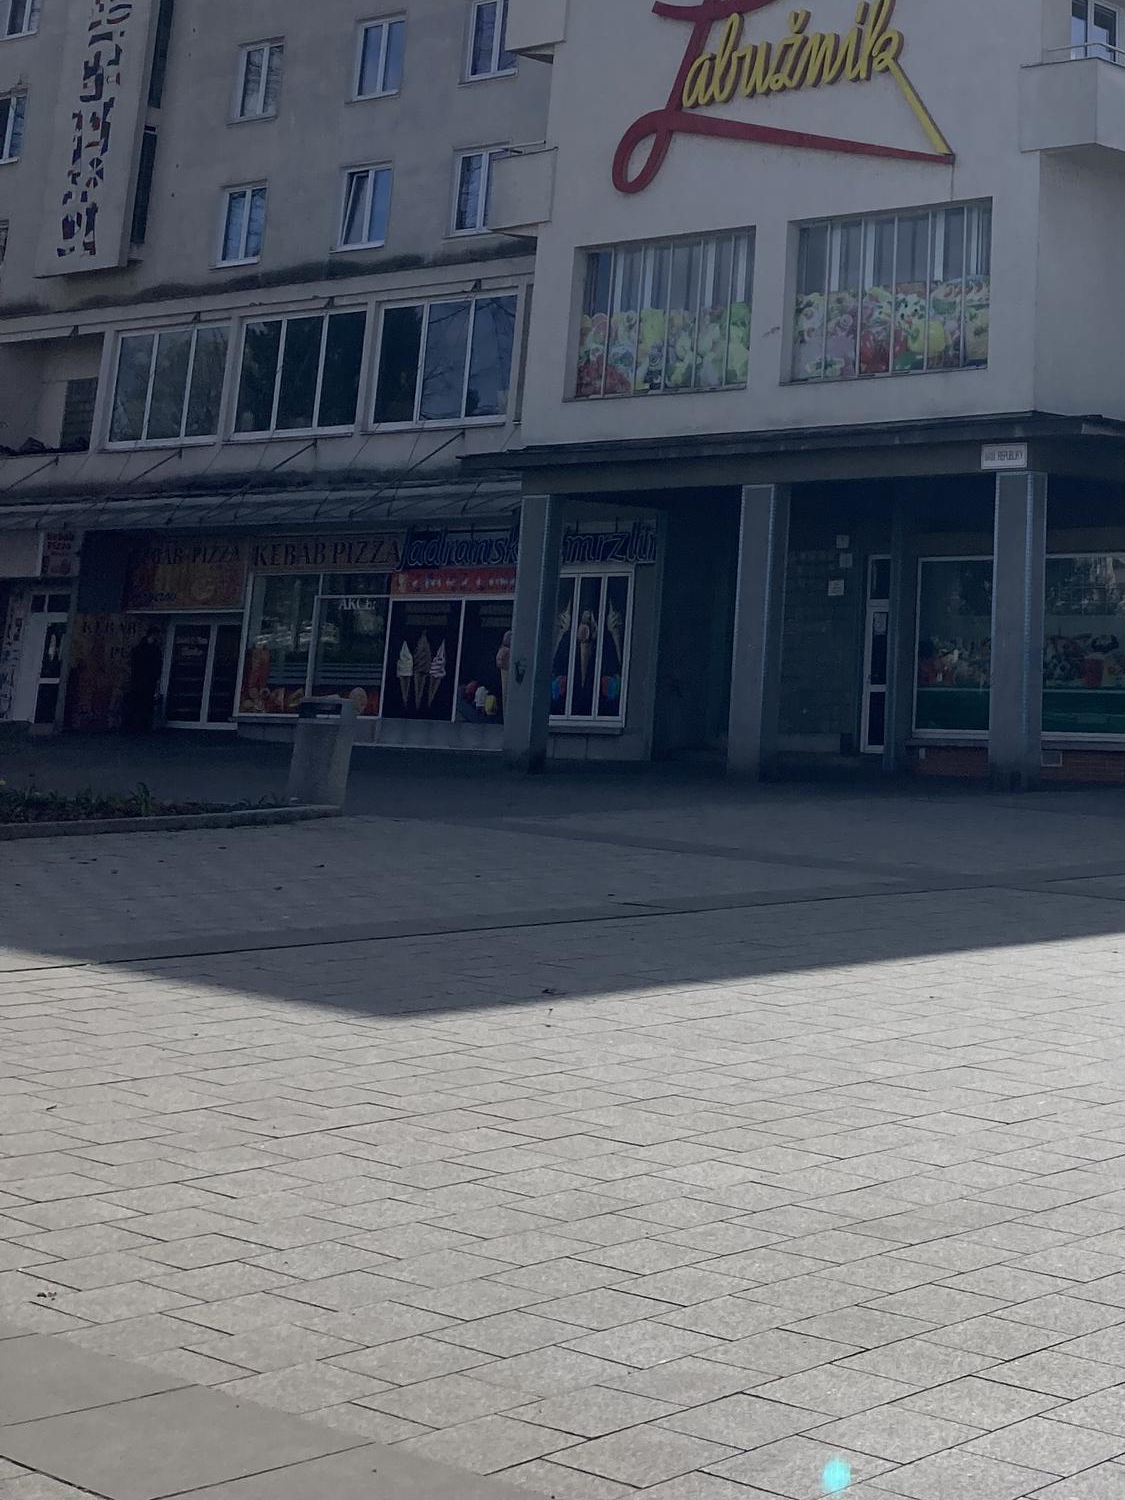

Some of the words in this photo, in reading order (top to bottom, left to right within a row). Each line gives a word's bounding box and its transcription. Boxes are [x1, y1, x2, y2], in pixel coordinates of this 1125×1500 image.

[254, 543, 327, 566] KEBAB
[331, 539, 400, 565] PIZZA
[394, 523, 519, 572] Jadransk
